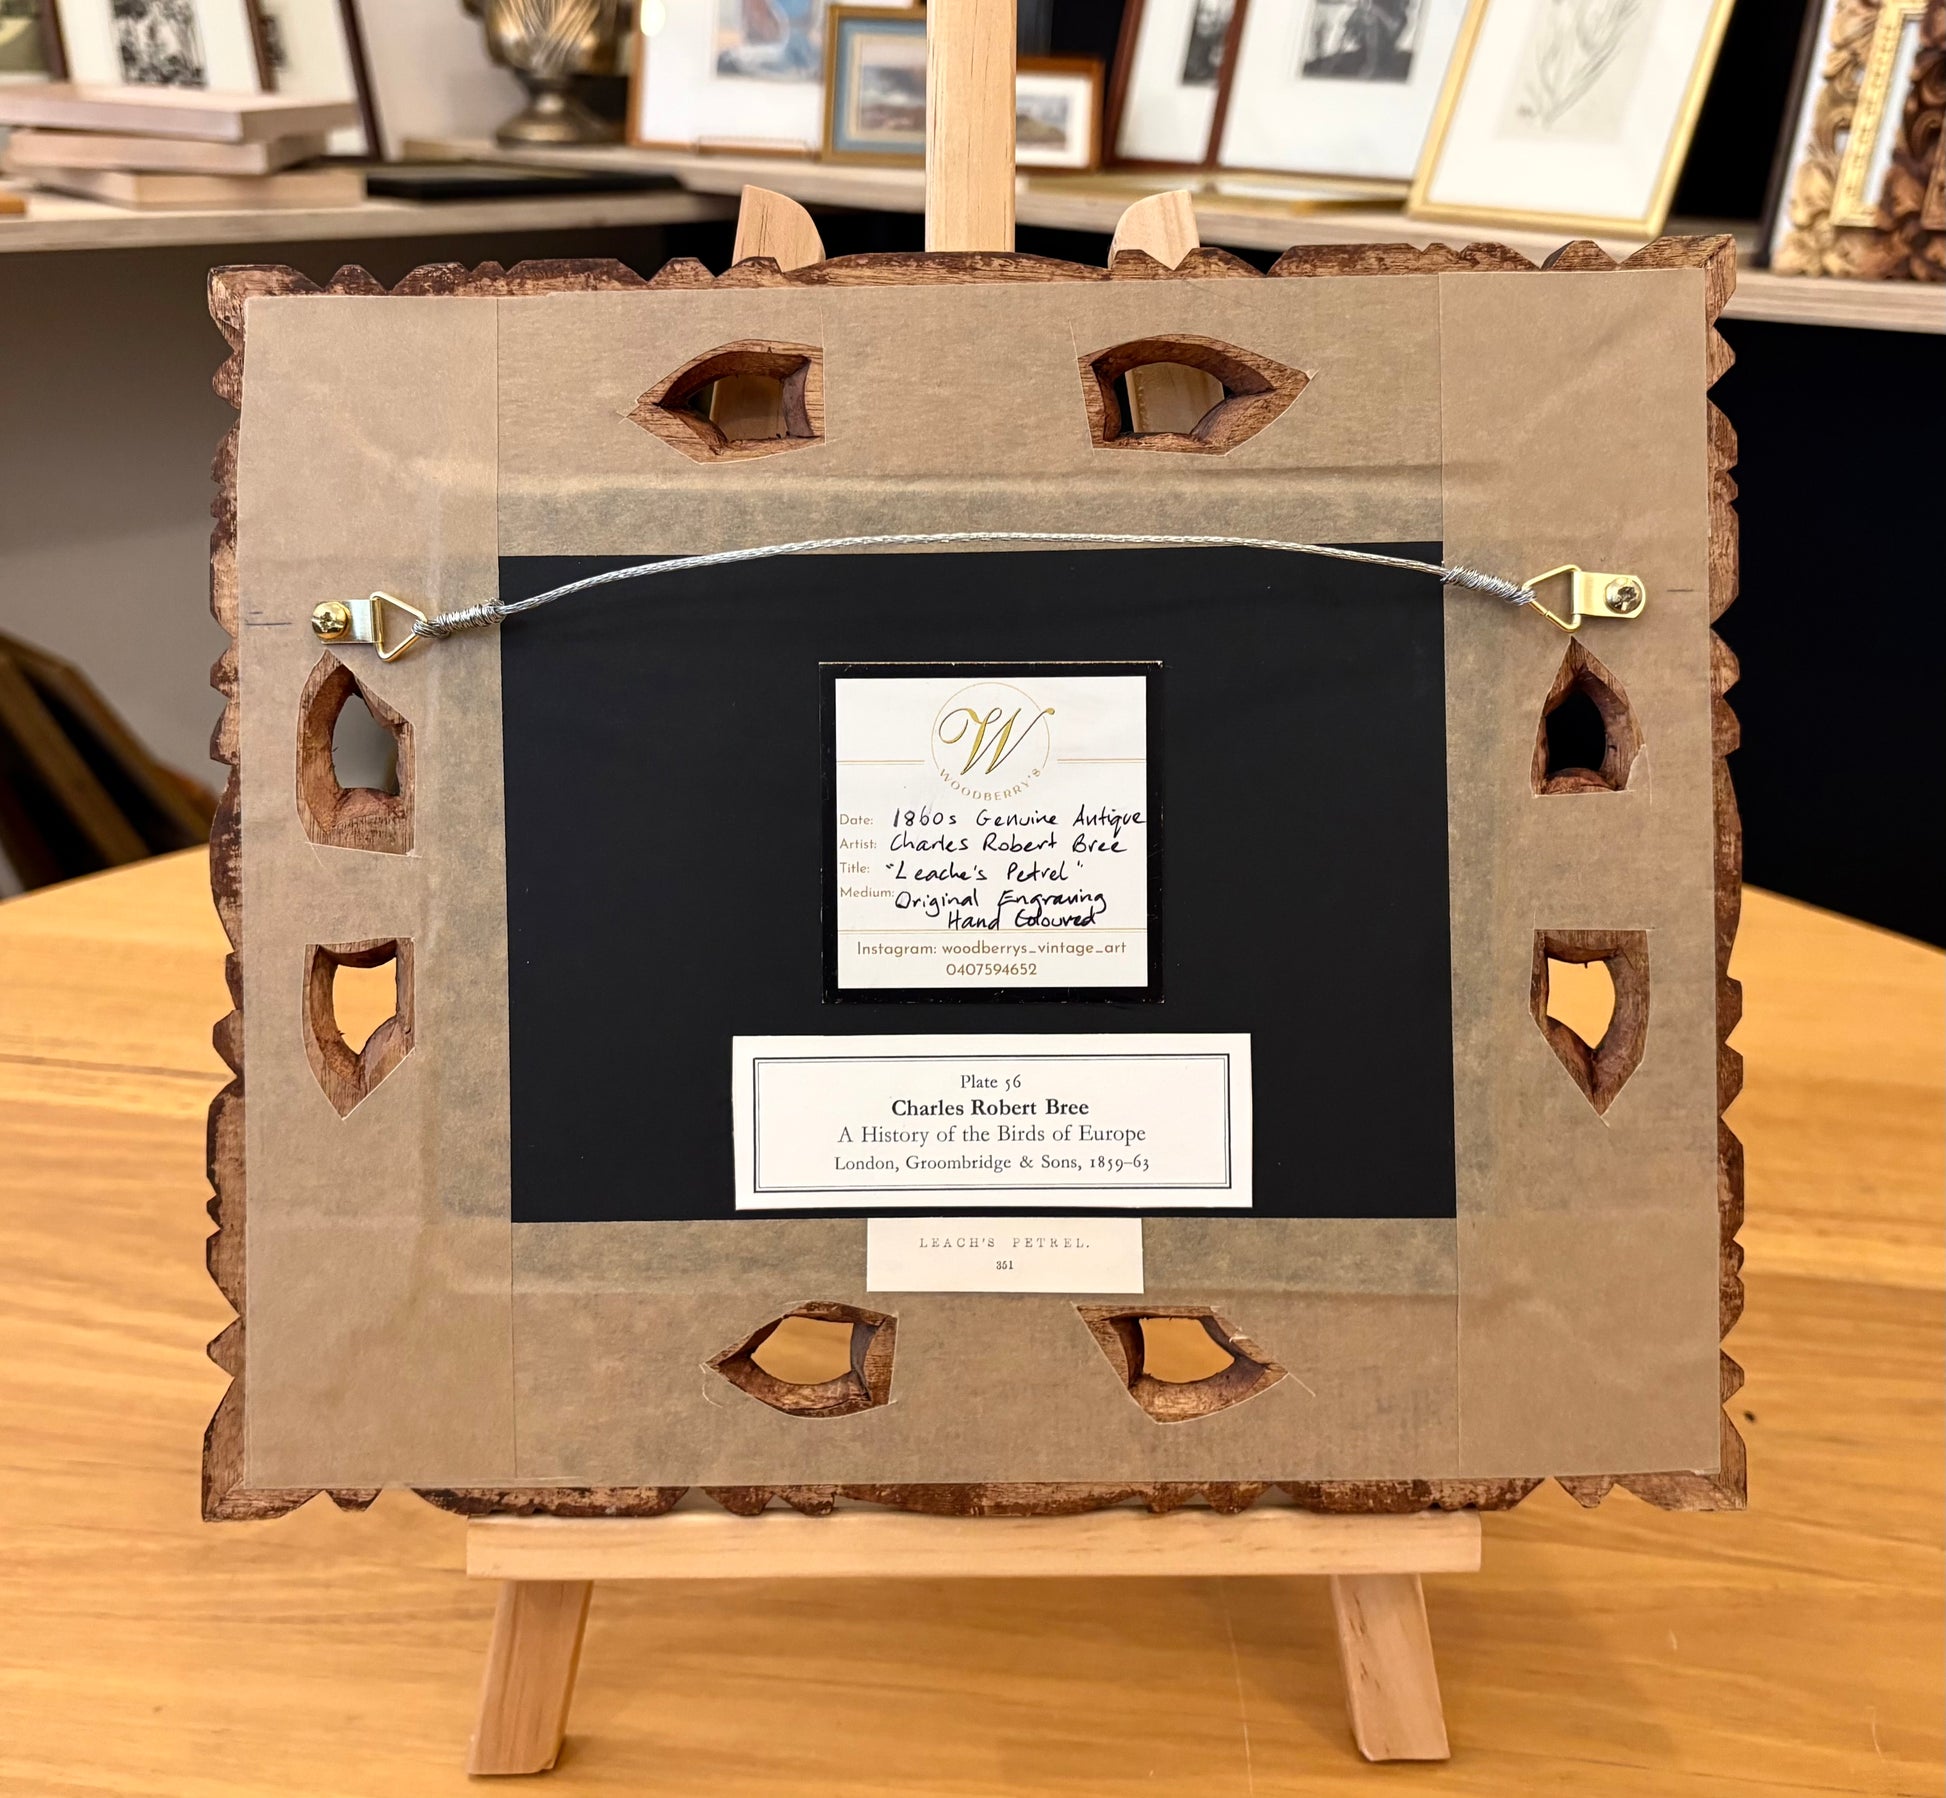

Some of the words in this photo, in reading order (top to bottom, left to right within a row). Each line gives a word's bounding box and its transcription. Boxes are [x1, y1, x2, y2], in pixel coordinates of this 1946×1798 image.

[938, 768, 1041, 801] WOODBERRY'S
[840, 814, 874, 825] Date:
[893, 805, 957, 827] 1860s
[976, 809, 1060, 826] Genuine
[1072, 804, 1146, 838] Antique
[840, 839, 877, 849] Artist:
[890, 830, 969, 851] Charles
[982, 831, 1057, 851] Robert
[1072, 833, 1128, 853] Bree
[840, 863, 870, 874] Title:
[840, 887, 894, 898] Medium:
[894, 888, 979, 917] Original
[997, 889, 1107, 914] Engraving
[948, 910, 1000, 930] Hand
[1014, 906, 1096, 927] Coloured
[857, 941, 937, 957] Instagram:
[942, 941, 1126, 957] woodberrys_vintage_art
[946, 963, 1037, 976] 0407594652
[960, 1075, 998, 1090] Plate
[1004, 1074, 1022, 1092] 56
[891, 1099, 965, 1116] Charles
[970, 1099, 1037, 1116] Robert
[1045, 1098, 1090, 1116] Bree
[837, 1127, 853, 1143] A
[861, 1126, 930, 1146] History
[936, 1125, 957, 1143] of
[962, 1126, 991, 1143] the
[997, 1124, 1045, 1143] Birds
[1052, 1124, 1074, 1143] of
[1078, 1125, 1146, 1146] Europe
[834, 1156, 900, 1174] London,
[905, 1155, 1012, 1173] Groombridge
[1019, 1156, 1034, 1170] &
[1041, 1155, 1082, 1172] Sons,
[919, 1237, 995, 1249] LEACH'S
[1012, 1237, 1091, 1249] PETREL.
